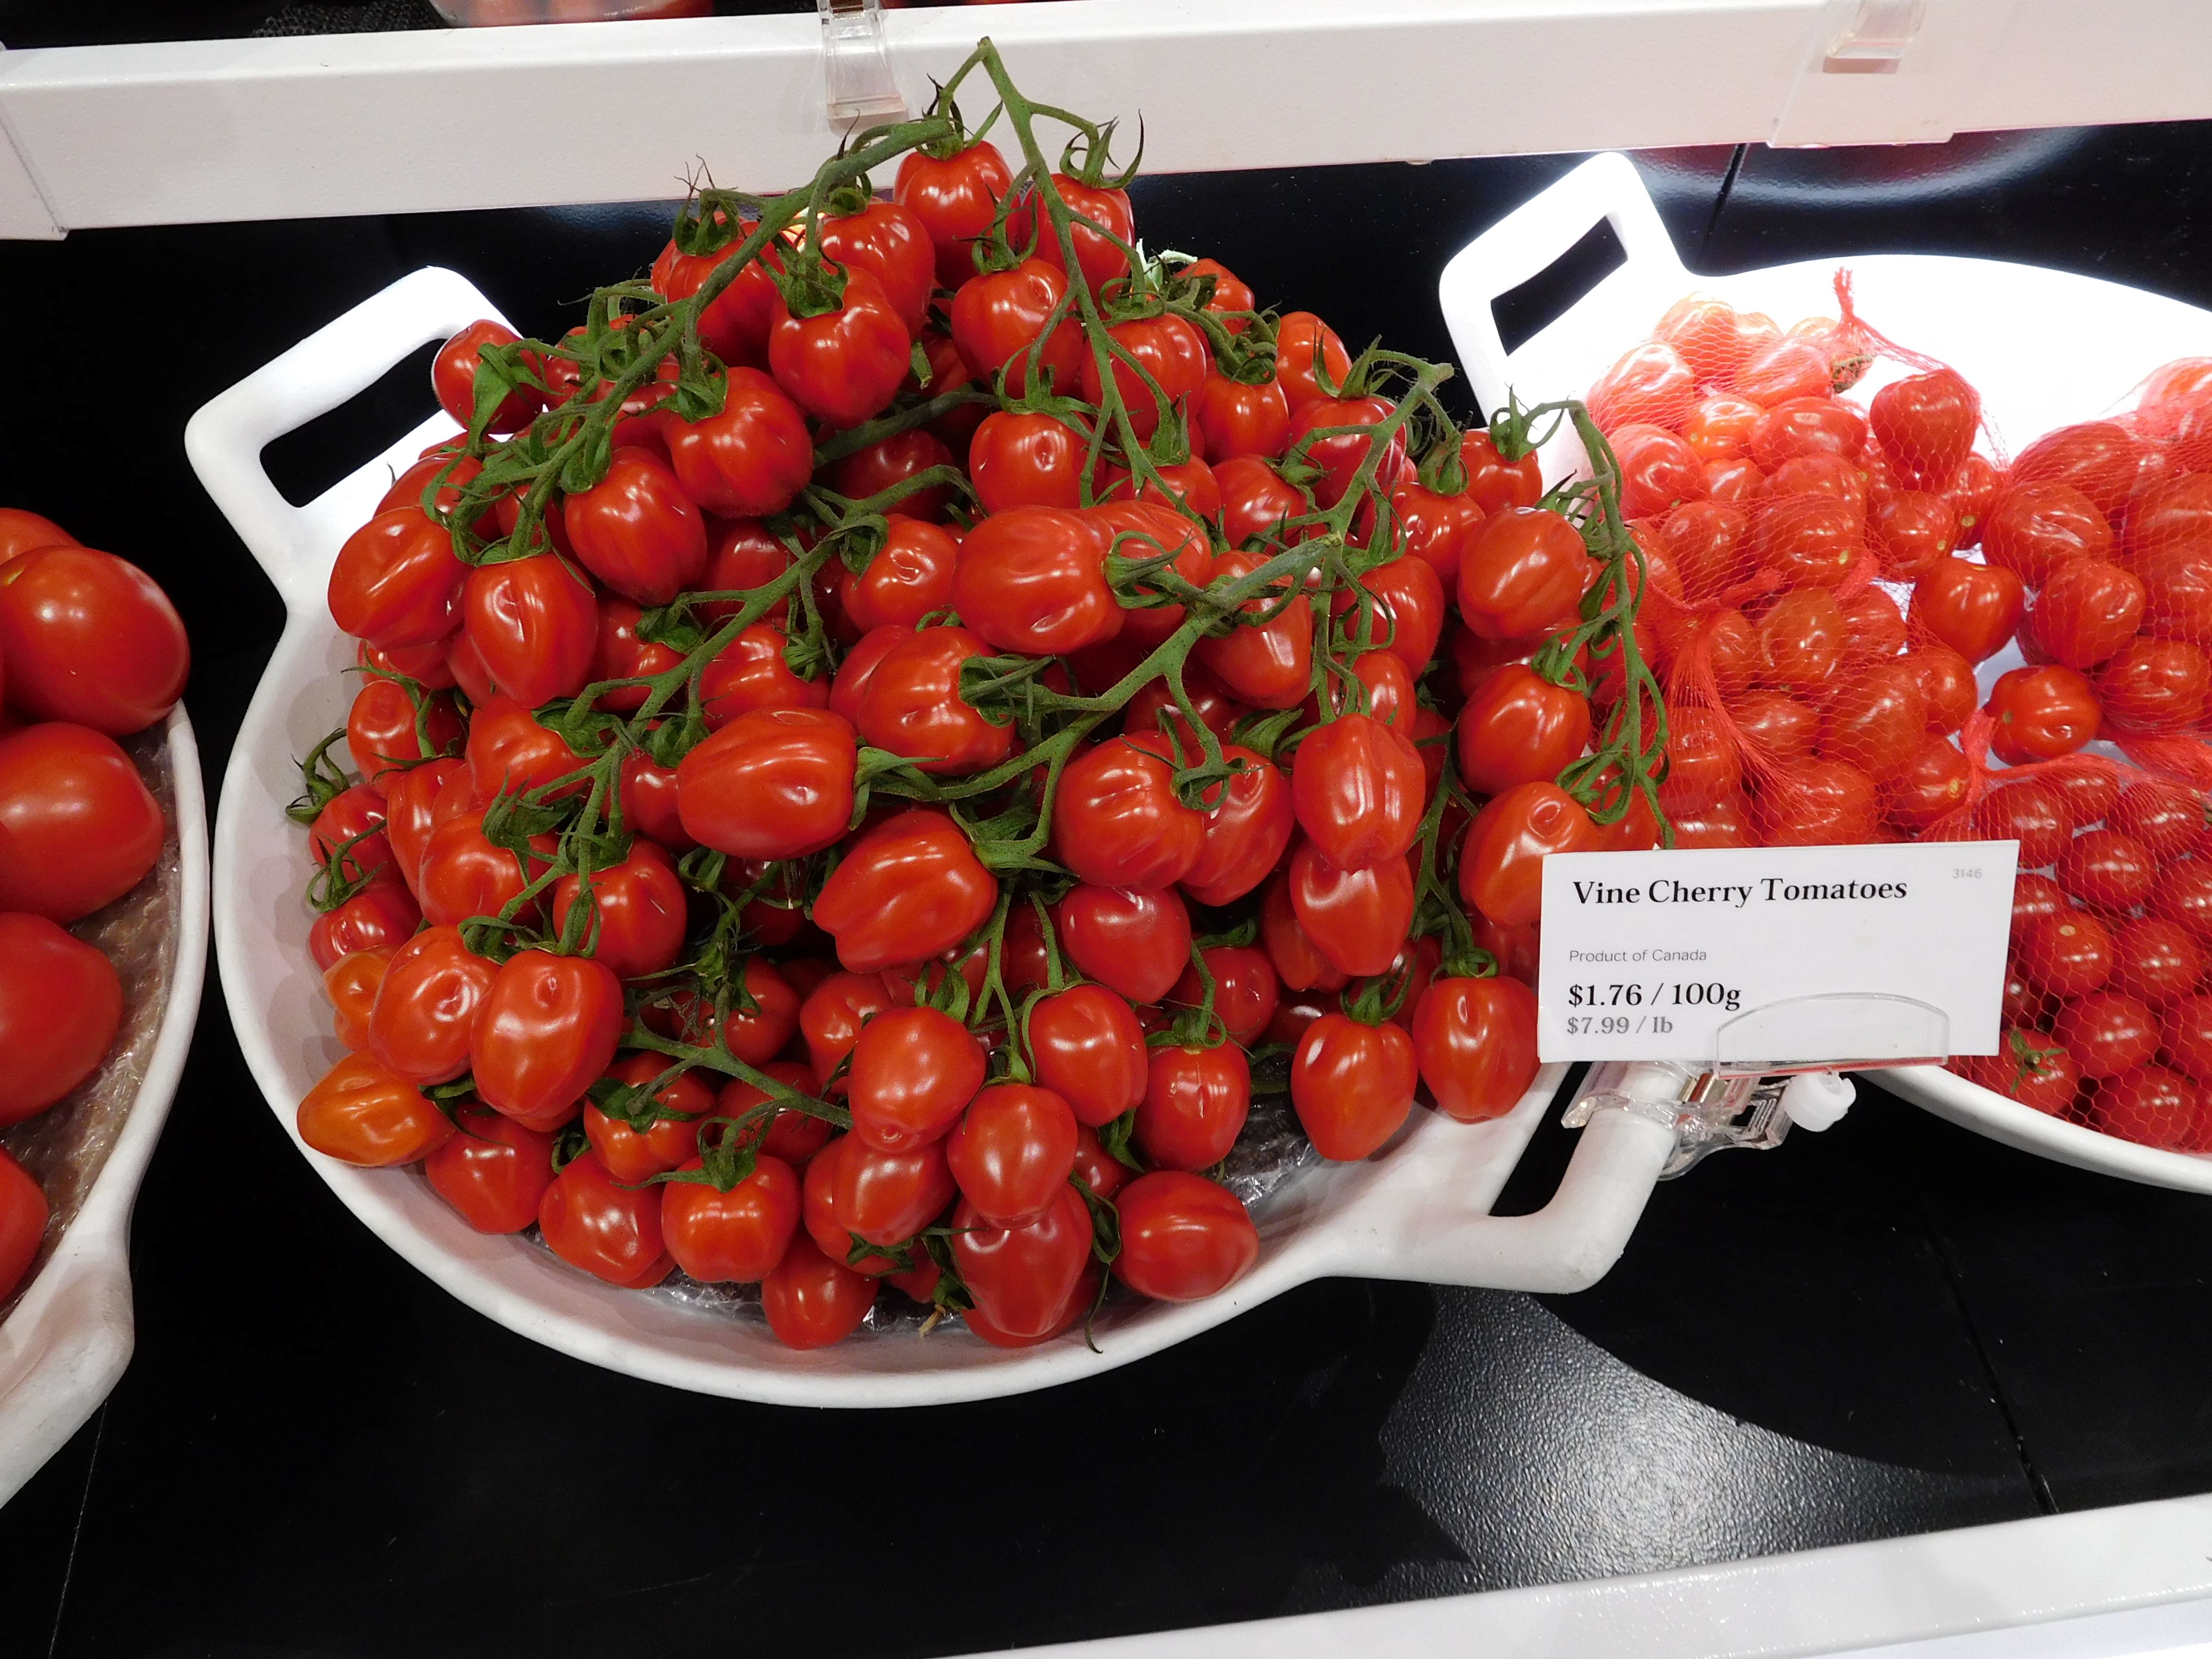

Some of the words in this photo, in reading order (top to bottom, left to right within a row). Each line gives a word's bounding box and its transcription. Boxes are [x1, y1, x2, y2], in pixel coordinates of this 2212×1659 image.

[1952, 868, 1982, 879] 3146
[1573, 881, 1640, 904] Vine
[1649, 880, 1753, 908] Cherry
[1761, 878, 1907, 901] Tomatoes
[1570, 950, 1626, 962] Product
[1632, 950, 1648, 962] of
[1652, 949, 1707, 961] Canada
[1568, 984, 1642, 1008] $1.76
[1672, 983, 1741, 1011] 100g
[1567, 1016, 1629, 1035] $7.99
[1653, 1016, 1673, 1033] lb
